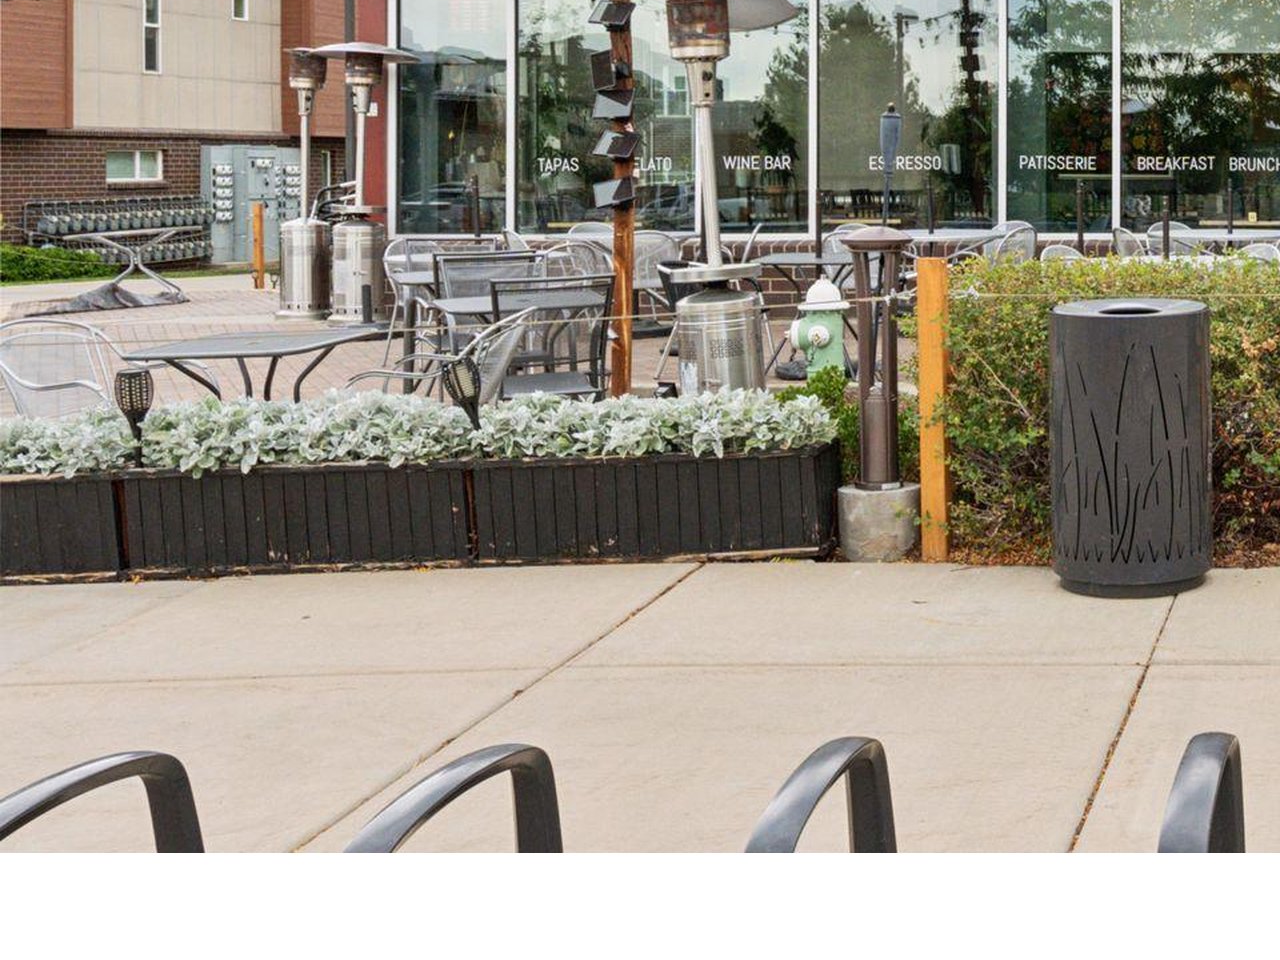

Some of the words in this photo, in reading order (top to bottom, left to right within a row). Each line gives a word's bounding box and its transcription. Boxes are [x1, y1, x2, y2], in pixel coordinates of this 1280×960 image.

[537, 157, 580, 172] TAPAS
[633, 156, 673, 172] ELATO
[722, 155, 760, 170] WINE
[764, 155, 792, 170] BAR
[868, 155, 942, 171] ESRESSO
[1019, 155, 1097, 170] PATISSERIE
[1136, 156, 1216, 171] BREAKFAST
